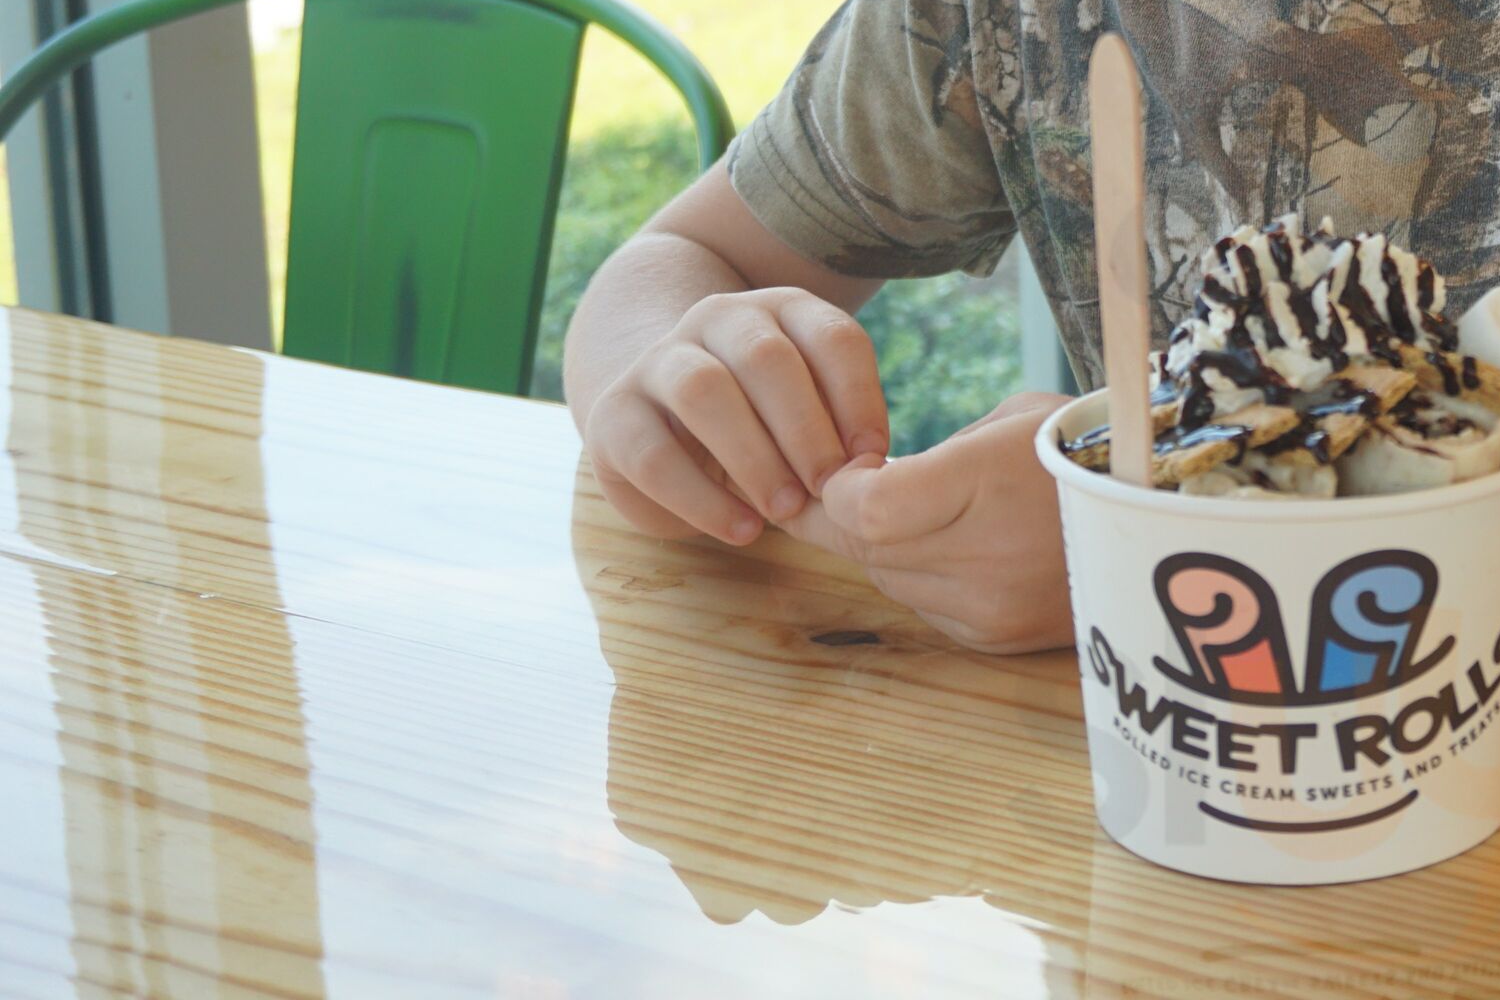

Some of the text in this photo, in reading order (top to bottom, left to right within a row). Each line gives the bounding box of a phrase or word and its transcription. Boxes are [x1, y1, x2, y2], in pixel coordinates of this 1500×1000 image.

[1087, 625, 1318, 775] SWEET
[1113, 716, 1171, 771] ROLLED
[1178, 765, 1211, 789] ICE
[1219, 779, 1296, 801] CREAM
[1305, 774, 1394, 802] SWEETS
[1402, 754, 1443, 783] AND
